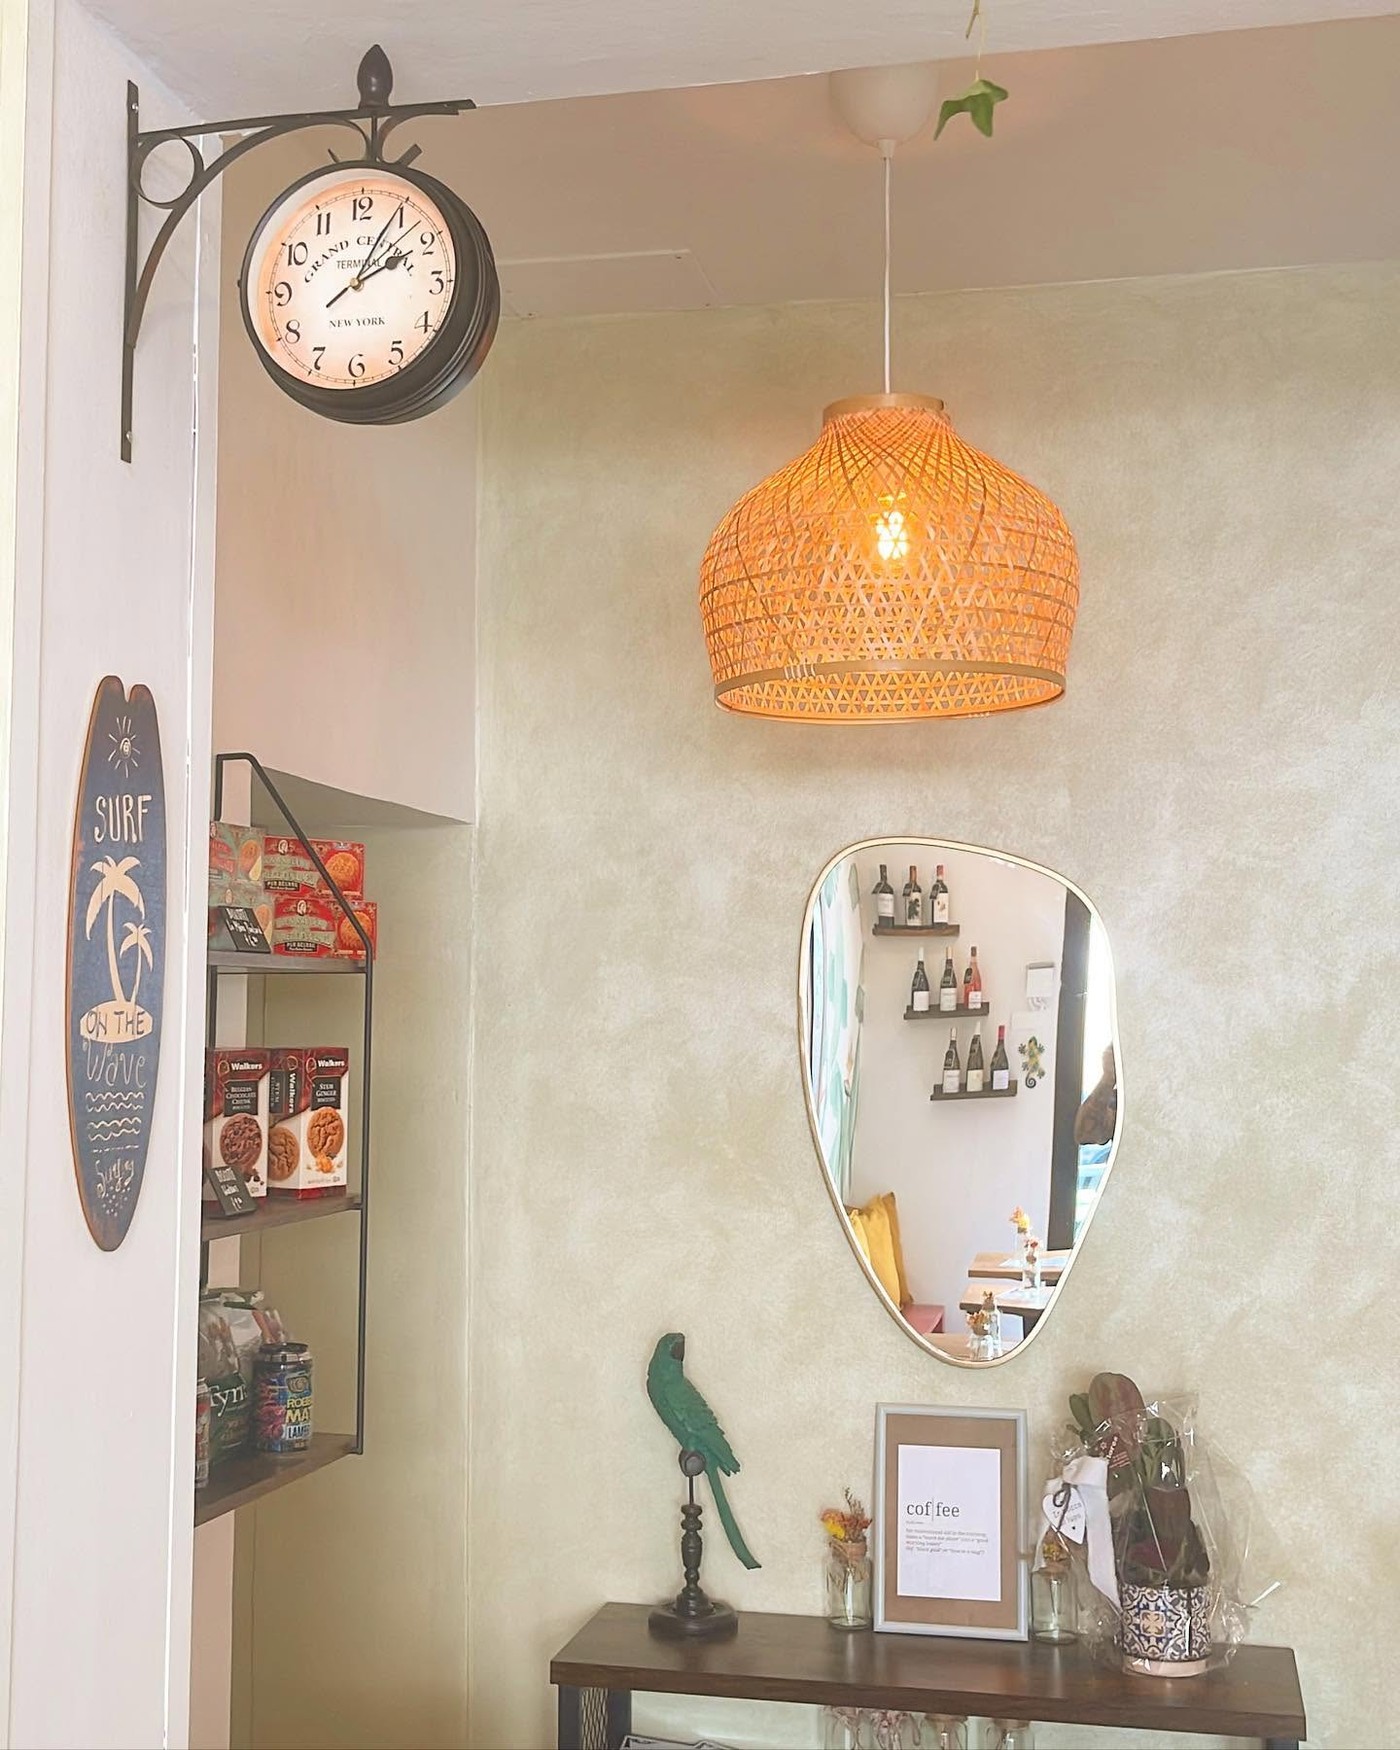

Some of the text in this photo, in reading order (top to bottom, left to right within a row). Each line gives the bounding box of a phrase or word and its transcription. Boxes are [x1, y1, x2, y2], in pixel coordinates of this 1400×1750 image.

[352, 196, 373, 221] 12
[398, 204, 405, 229] 1
[316, 212, 331, 236] 11
[287, 241, 308, 266] 10
[420, 231, 435, 256] 2
[304, 240, 349, 283] GRAND
[274, 281, 292, 307] 9
[428, 270, 445, 295] 3
[284, 319, 300, 344] 8
[329, 316, 386, 328] NEW YORK
[414, 310, 433, 334] 4
[312, 346, 326, 371] 7
[388, 340, 404, 366] 5
[348, 354, 366, 378] 6
[93, 794, 152, 844] SURF
[86, 1010, 146, 1037] ON THE
[231, 1062, 262, 1071] Walkers
[317, 1060, 345, 1068] Walkers
